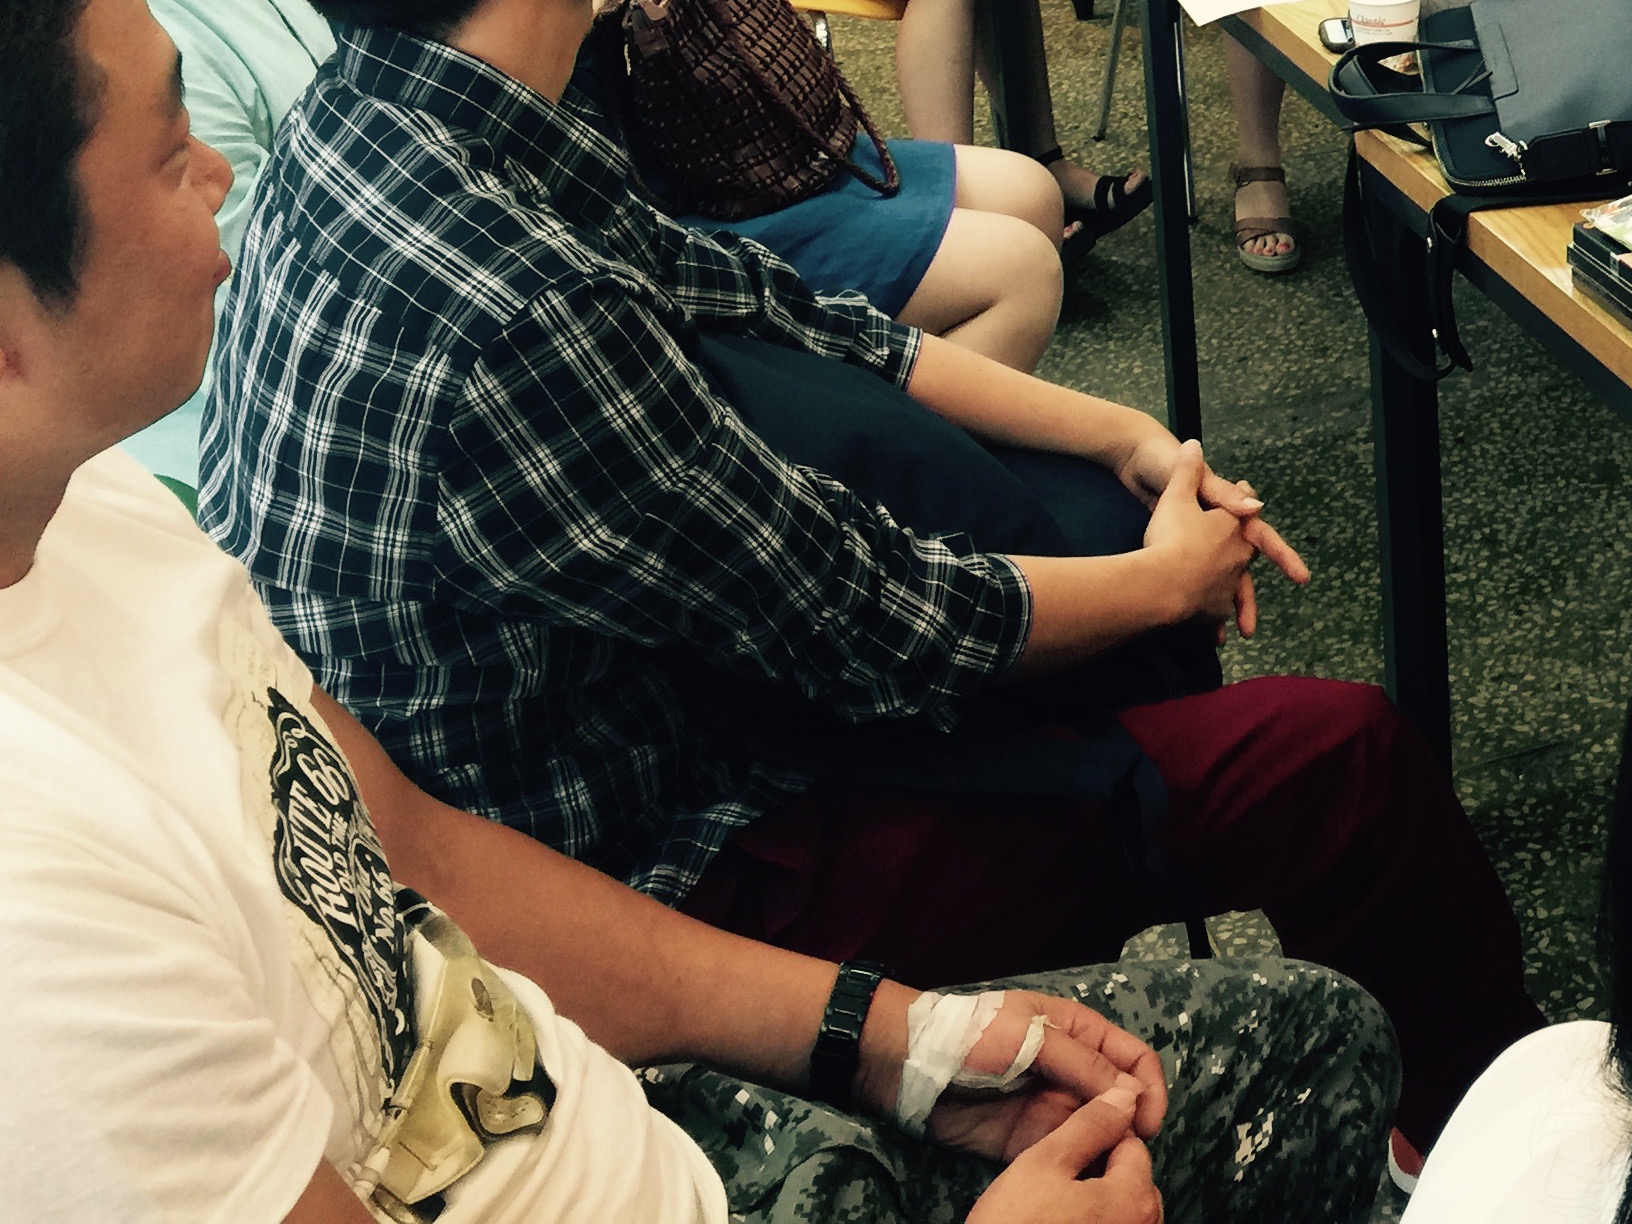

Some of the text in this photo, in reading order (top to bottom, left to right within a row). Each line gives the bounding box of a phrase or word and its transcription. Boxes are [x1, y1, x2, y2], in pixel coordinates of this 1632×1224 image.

[288, 747, 361, 933] ROUTE 66
[331, 811, 348, 851] TIME
